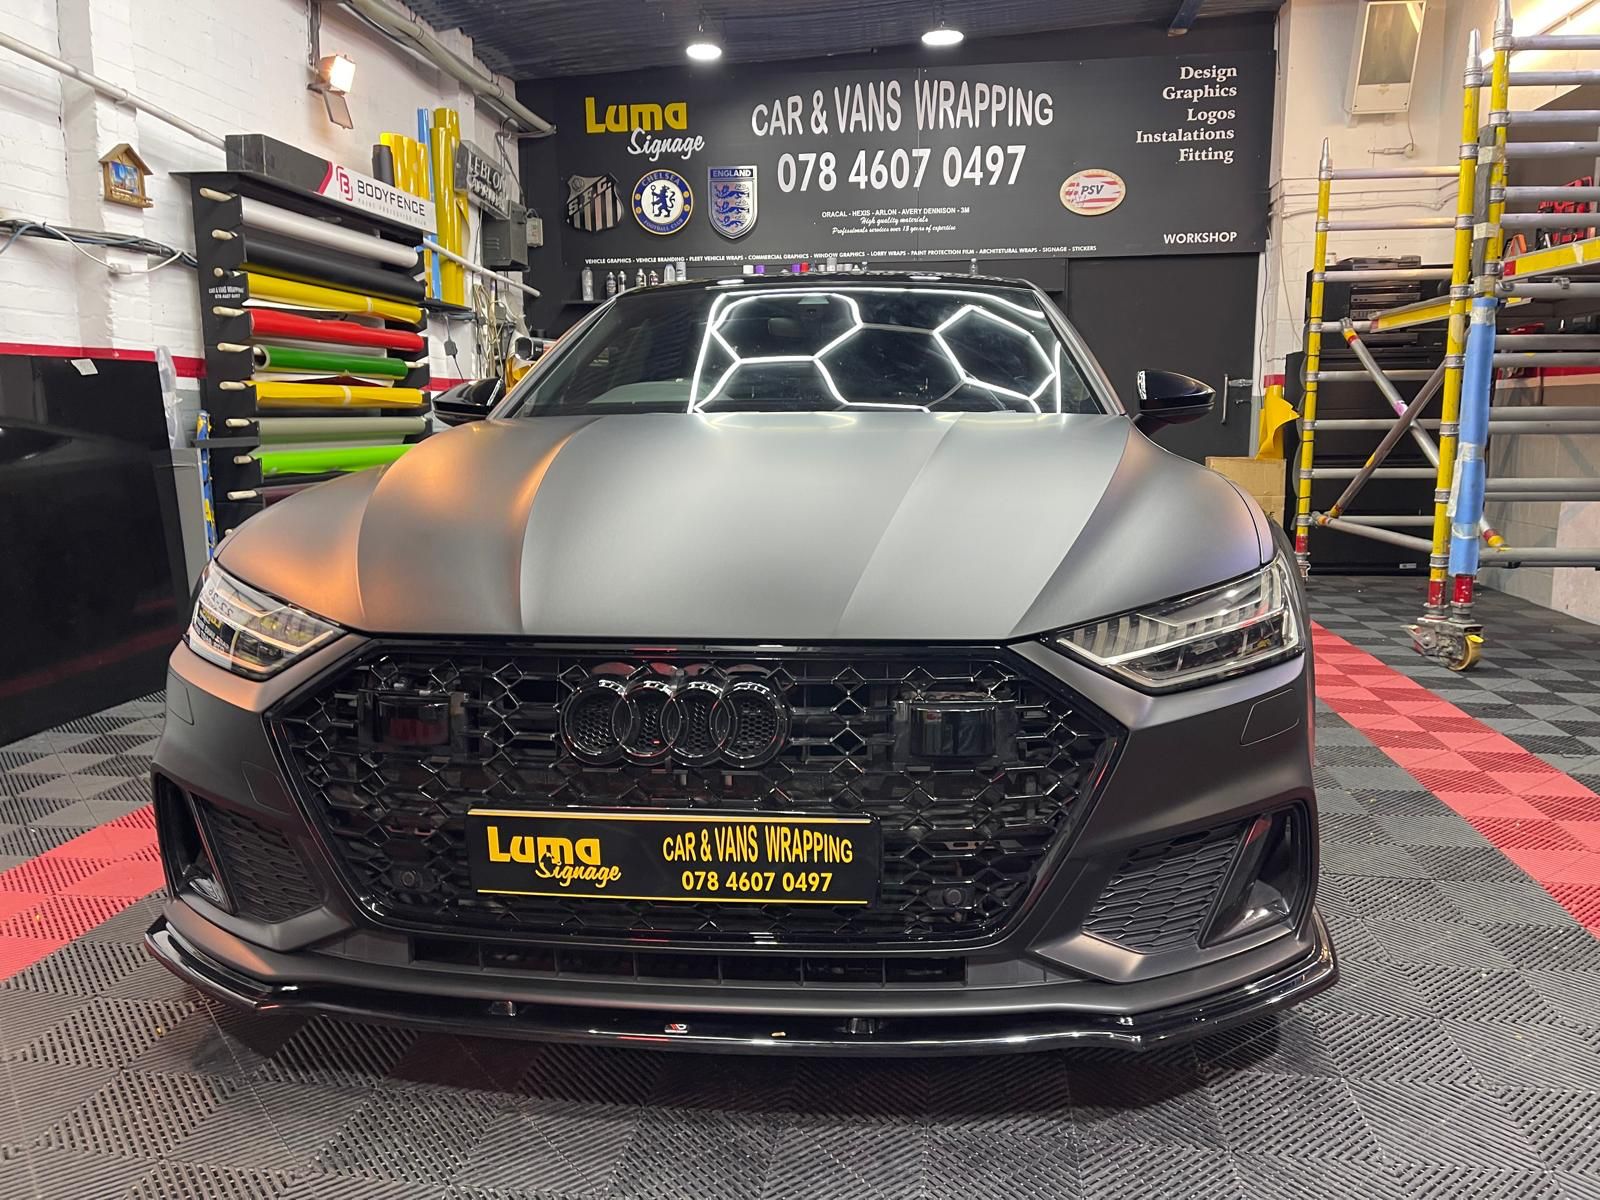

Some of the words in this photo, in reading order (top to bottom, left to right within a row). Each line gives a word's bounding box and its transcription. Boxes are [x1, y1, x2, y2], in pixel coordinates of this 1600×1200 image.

[1180, 65, 1238, 81] Design
[1162, 85, 1238, 102] Graphics
[585, 96, 688, 134] Luma
[752, 95, 803, 136] CAR
[810, 89, 829, 135] &
[833, 78, 902, 134] VANS
[914, 79, 1053, 130] WRAPPING
[1187, 107, 1236, 123] Logos
[627, 127, 706, 162] Signage
[1136, 128, 1235, 144] Instalations
[1178, 148, 1234, 165] Fitting
[712, 169, 753, 178] ENGLAND
[777, 151, 838, 193] 078
[848, 147, 931, 190] 4607
[942, 144, 1027, 187] 0497
[641, 172, 681, 187] CHELSEA
[357, 179, 426, 217] BODYFENCE
[1080, 184, 1105, 196] PSV
[852, 209, 871, 217] HEXIS
[875, 208, 897, 216] ARLON
[901, 207, 923, 215] AVERY
[923, 206, 956, 215] DENNISON
[877, 216, 899, 226] quality
[899, 215, 928, 223] materials
[1163, 231, 1238, 245] WORKSHOP
[486, 826, 601, 866] Luma
[663, 832, 697, 861] CAR
[700, 828, 712, 861] &
[714, 825, 758, 862] VANS
[765, 825, 853, 863] WRAPPING
[535, 850, 622, 889] Signage
[681, 871, 719, 890] 078
[725, 871, 775, 891] 4607
[782, 872, 833, 892] 0497
